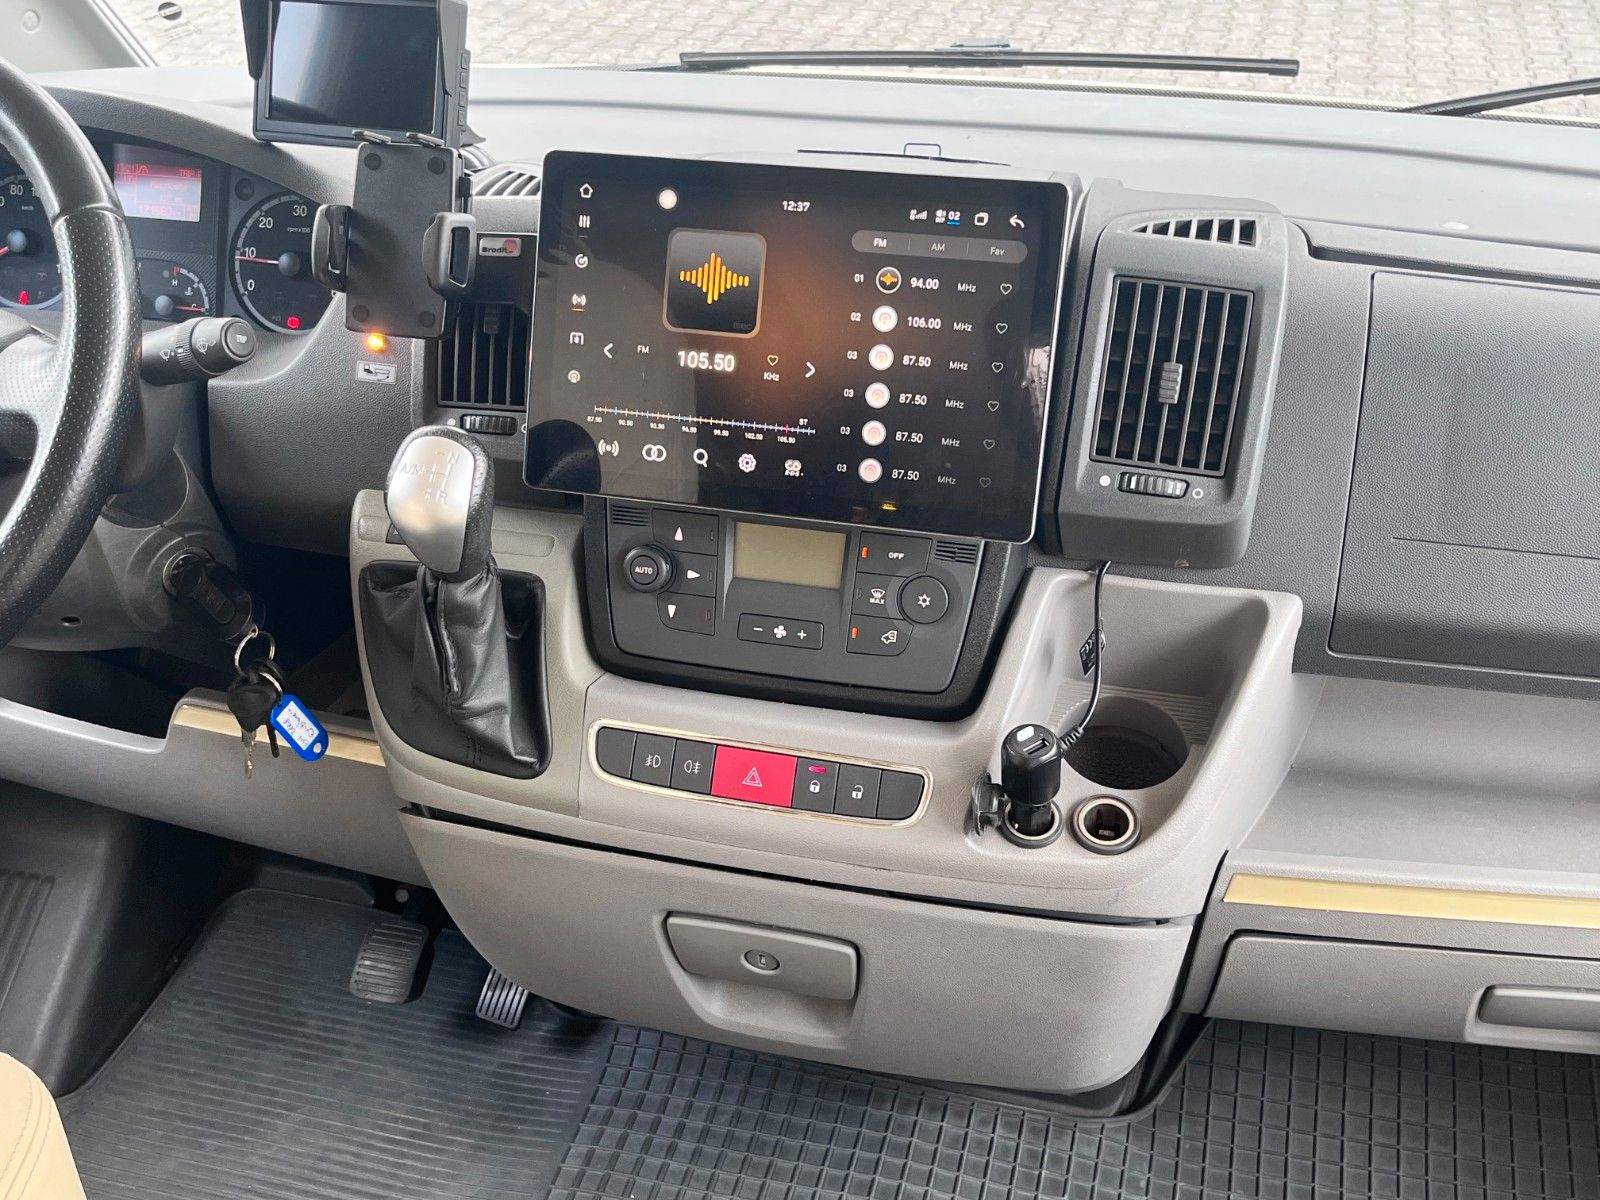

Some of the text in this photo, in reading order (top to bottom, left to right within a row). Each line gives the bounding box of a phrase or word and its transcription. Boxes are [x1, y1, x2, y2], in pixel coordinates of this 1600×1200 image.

[10, 184, 24, 196] 80
[292, 205, 307, 217] 30
[782, 201, 810, 213] 12:37
[948, 211, 960, 221] 02
[258, 217, 273, 229] 20
[873, 237, 887, 248] FM
[930, 243, 946, 252] AM
[244, 247, 257, 258] 10
[990, 246, 1005, 256] Fav
[247, 279, 255, 291] 0
[854, 273, 977, 293] 01 94.00 MHz
[850, 311, 973, 332] 02 106.00 MHz
[637, 344, 736, 372] FM 105.50
[847, 350, 969, 371] 03 87.50 MHz
[763, 371, 780, 381] KHz
[843, 388, 965, 409] 03 87.50 MHz
[840, 426, 961, 447] 03 87.50 MHz
[836, 463, 957, 485] 03 87.50 MHz
[888, 551, 905, 560] OFF
[634, 566, 653, 574] AUTO
